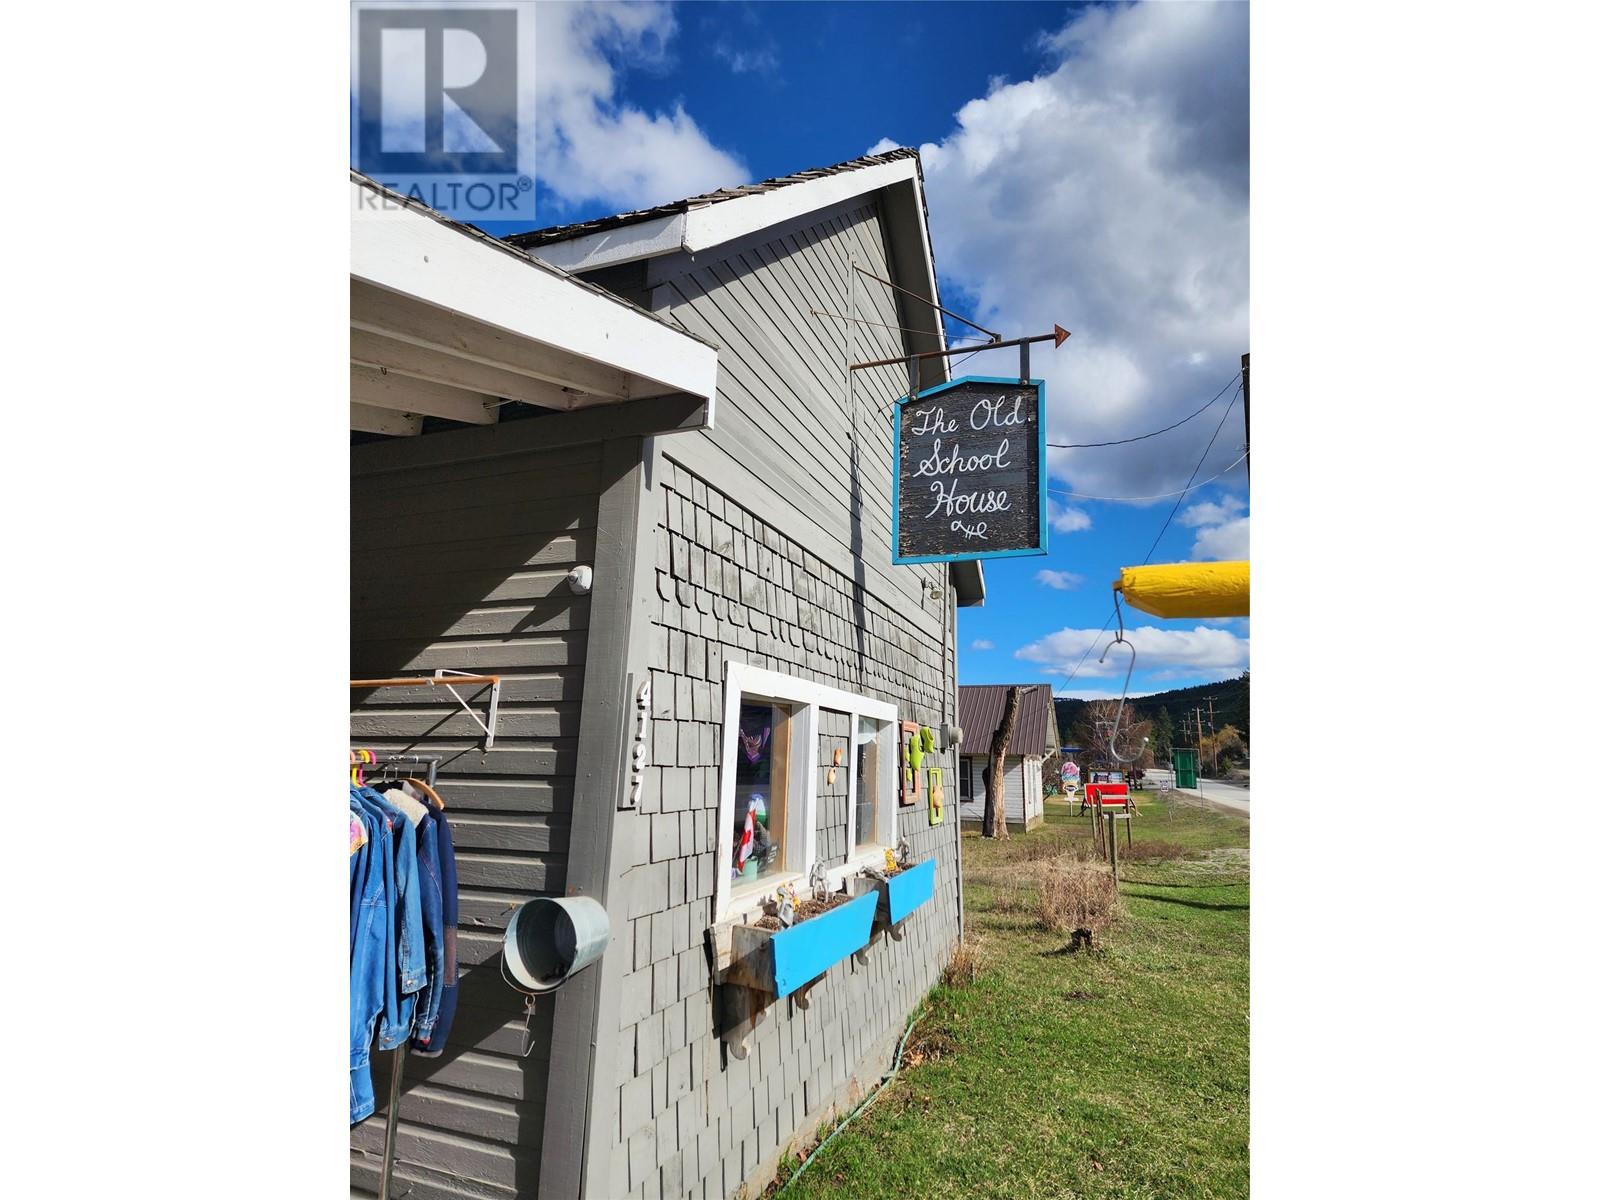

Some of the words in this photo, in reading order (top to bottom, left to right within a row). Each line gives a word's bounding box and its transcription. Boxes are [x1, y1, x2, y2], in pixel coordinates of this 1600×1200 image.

[911, 406, 959, 435] The
[970, 395, 1025, 430] Old
[912, 438, 1011, 478] School
[925, 478, 1012, 519] House
[632, 680, 651, 804] 4127
